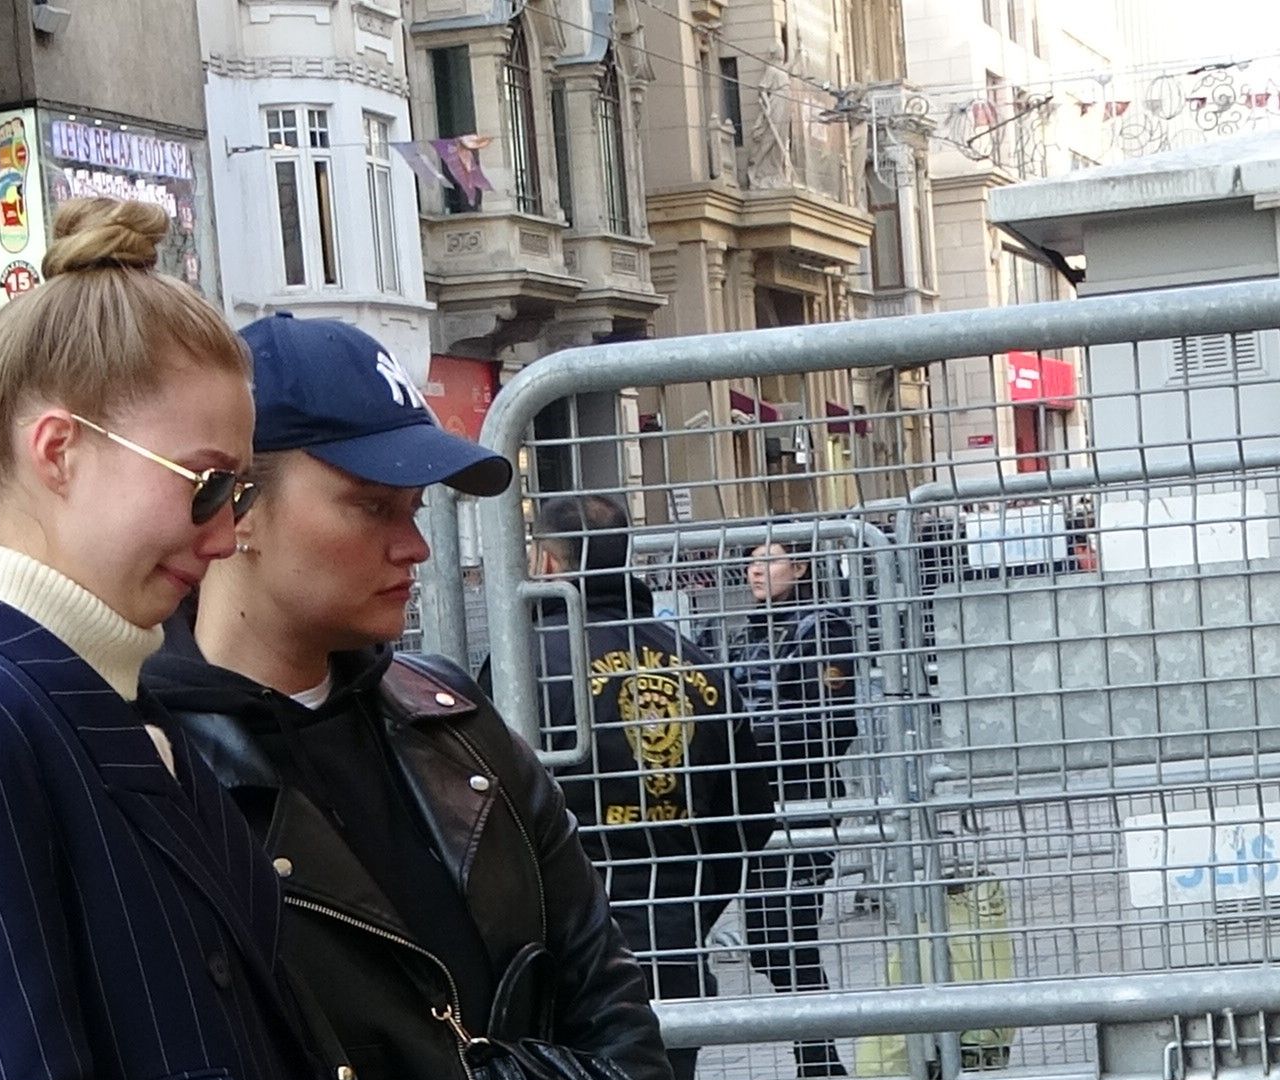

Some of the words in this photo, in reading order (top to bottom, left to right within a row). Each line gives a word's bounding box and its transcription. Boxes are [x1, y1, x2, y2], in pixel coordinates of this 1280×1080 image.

[93, 127, 134, 168] RELAX
[137, 135, 167, 173] FOOT
[169, 141, 193, 178] SPA
[7, 272, 30, 291] 15
[376, 351, 423, 409] NY
